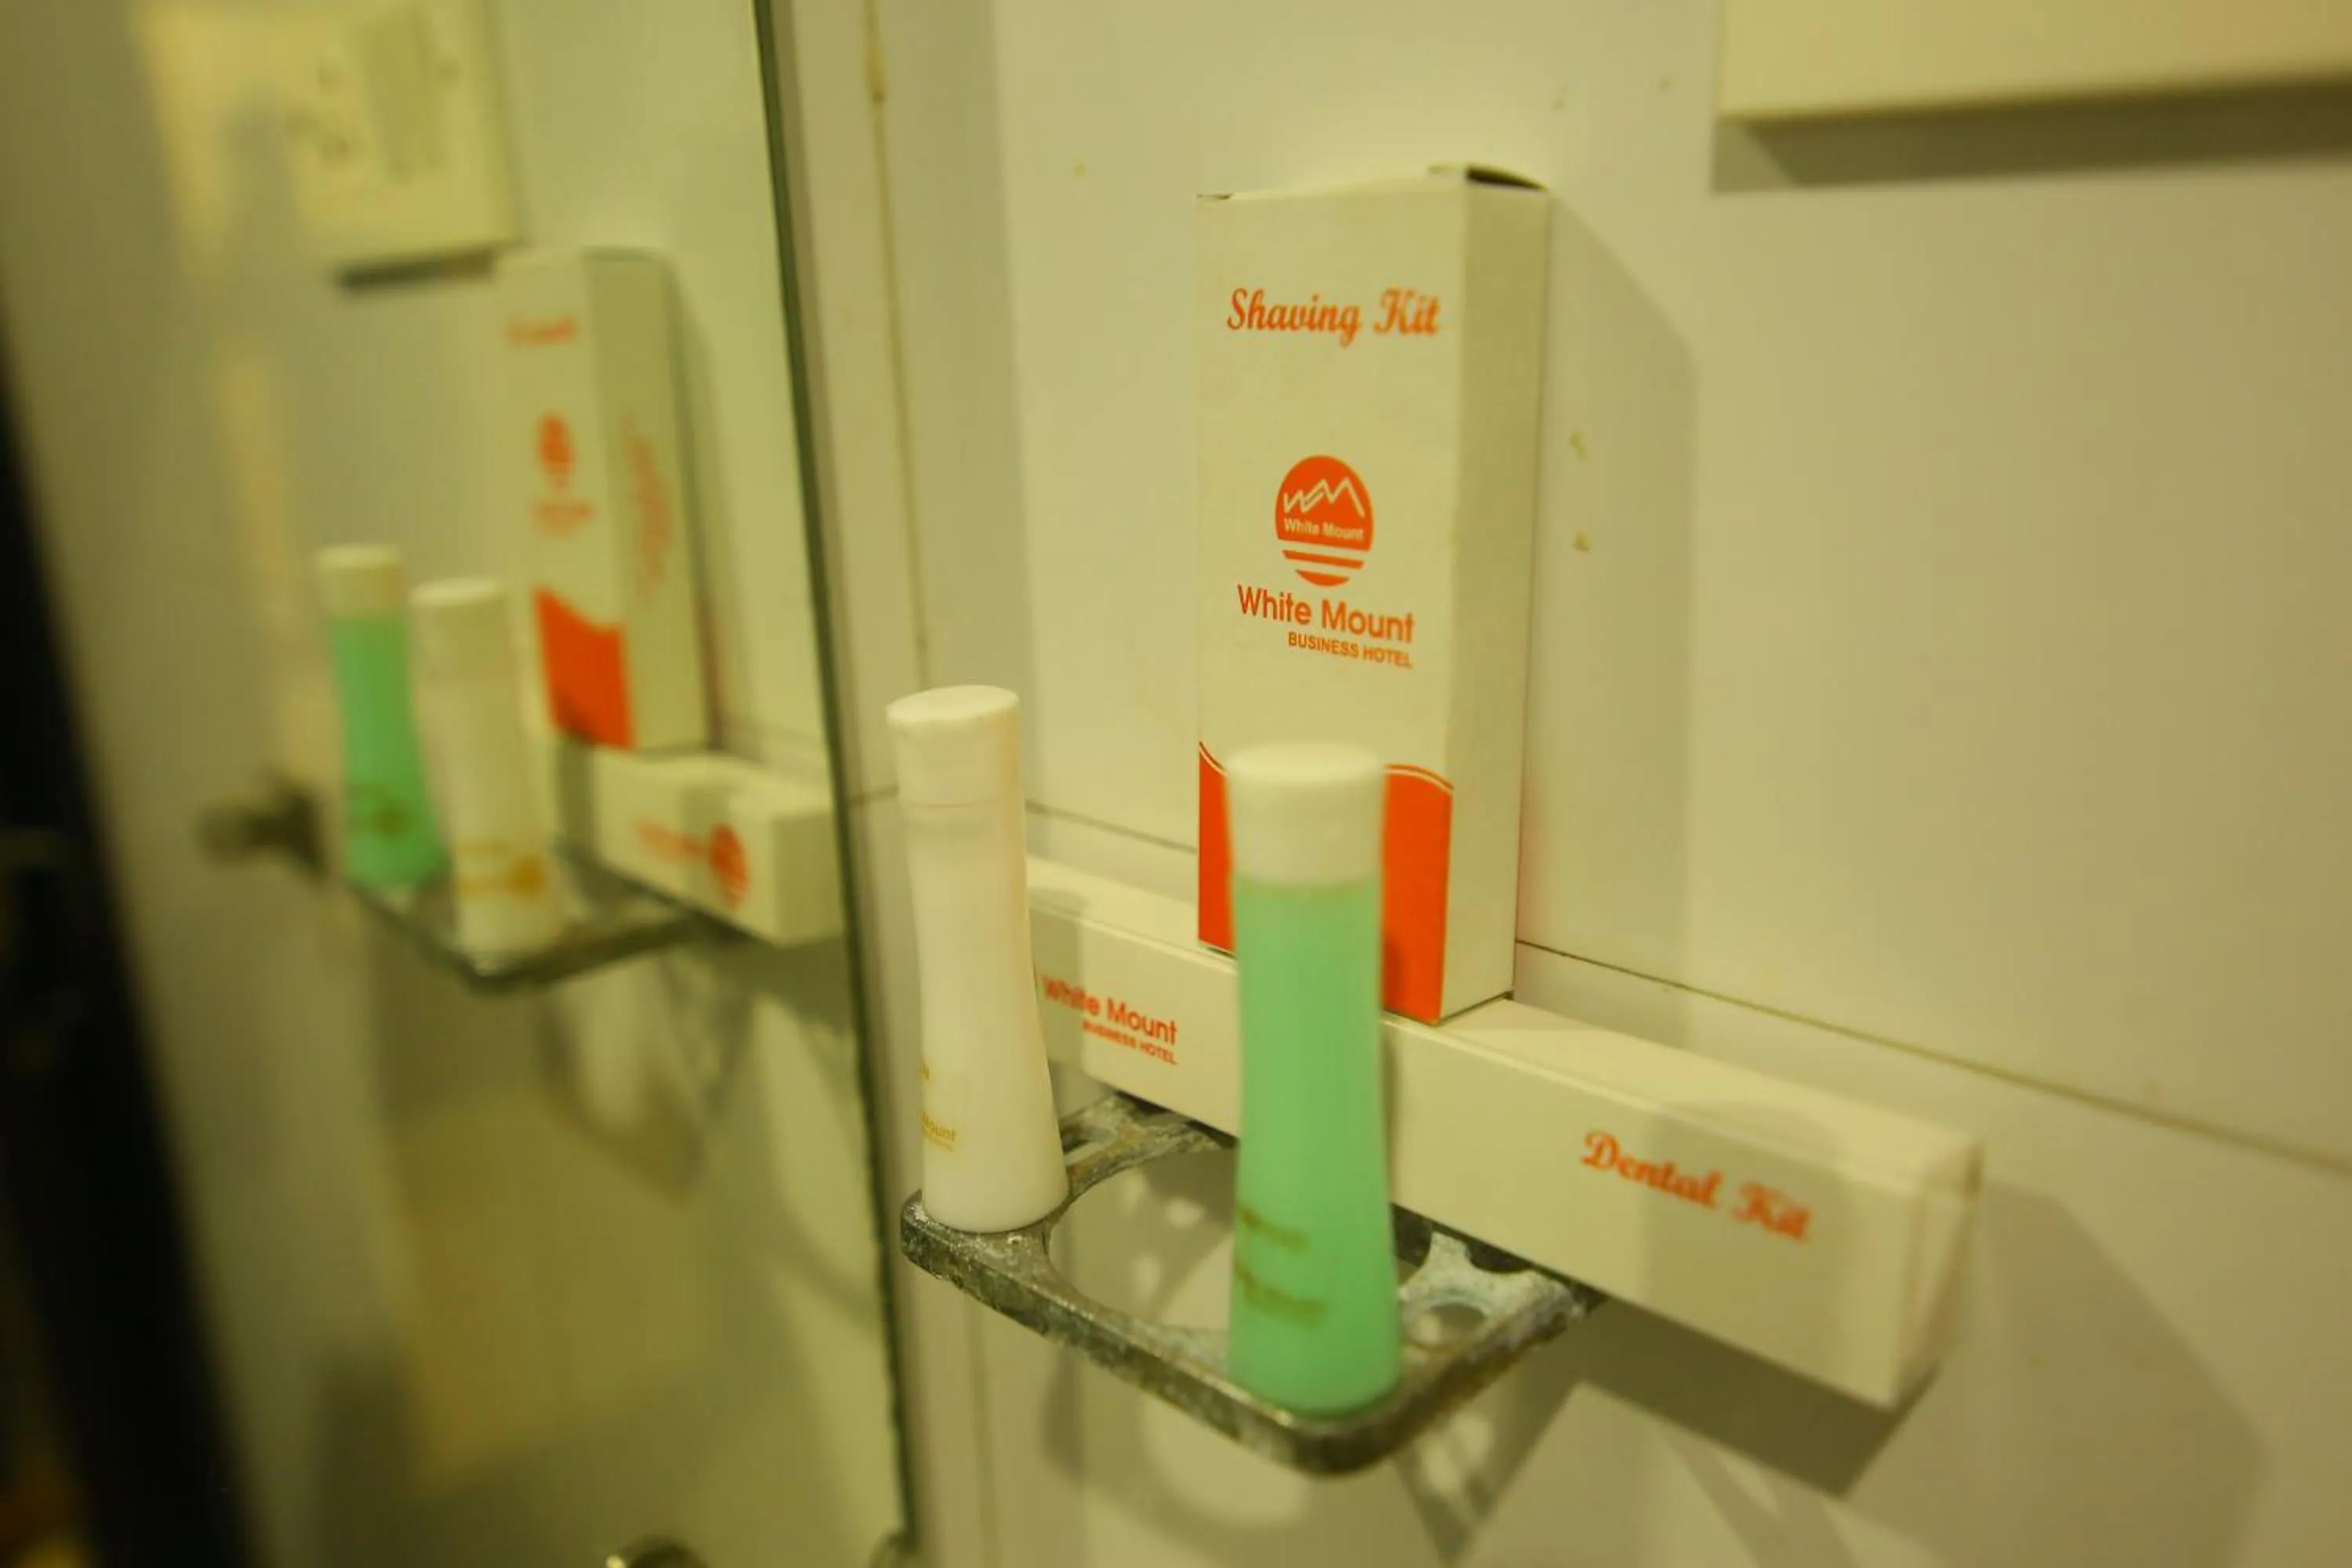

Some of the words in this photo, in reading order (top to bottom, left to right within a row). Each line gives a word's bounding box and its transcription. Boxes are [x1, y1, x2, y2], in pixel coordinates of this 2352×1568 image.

[1226, 287, 1361, 347] Shaving
[1373, 285, 1441, 336] Kit
[1283, 517, 1320, 536] White
[1322, 522, 1365, 541] Mount
[1236, 583, 1312, 625] White
[1320, 598, 1414, 644] Mount
[1287, 631, 1359, 659] BUSINESS
[1362, 645, 1413, 669] HOTEL
[1043, 976, 1100, 1016] White
[1106, 996, 1177, 1046] Mount
[1082, 1020, 1137, 1049] BUSINESS
[1138, 1041, 1178, 1065] HOTEL
[1580, 1130, 1722, 1210] Dental
[1732, 1182, 1811, 1242] Kit
